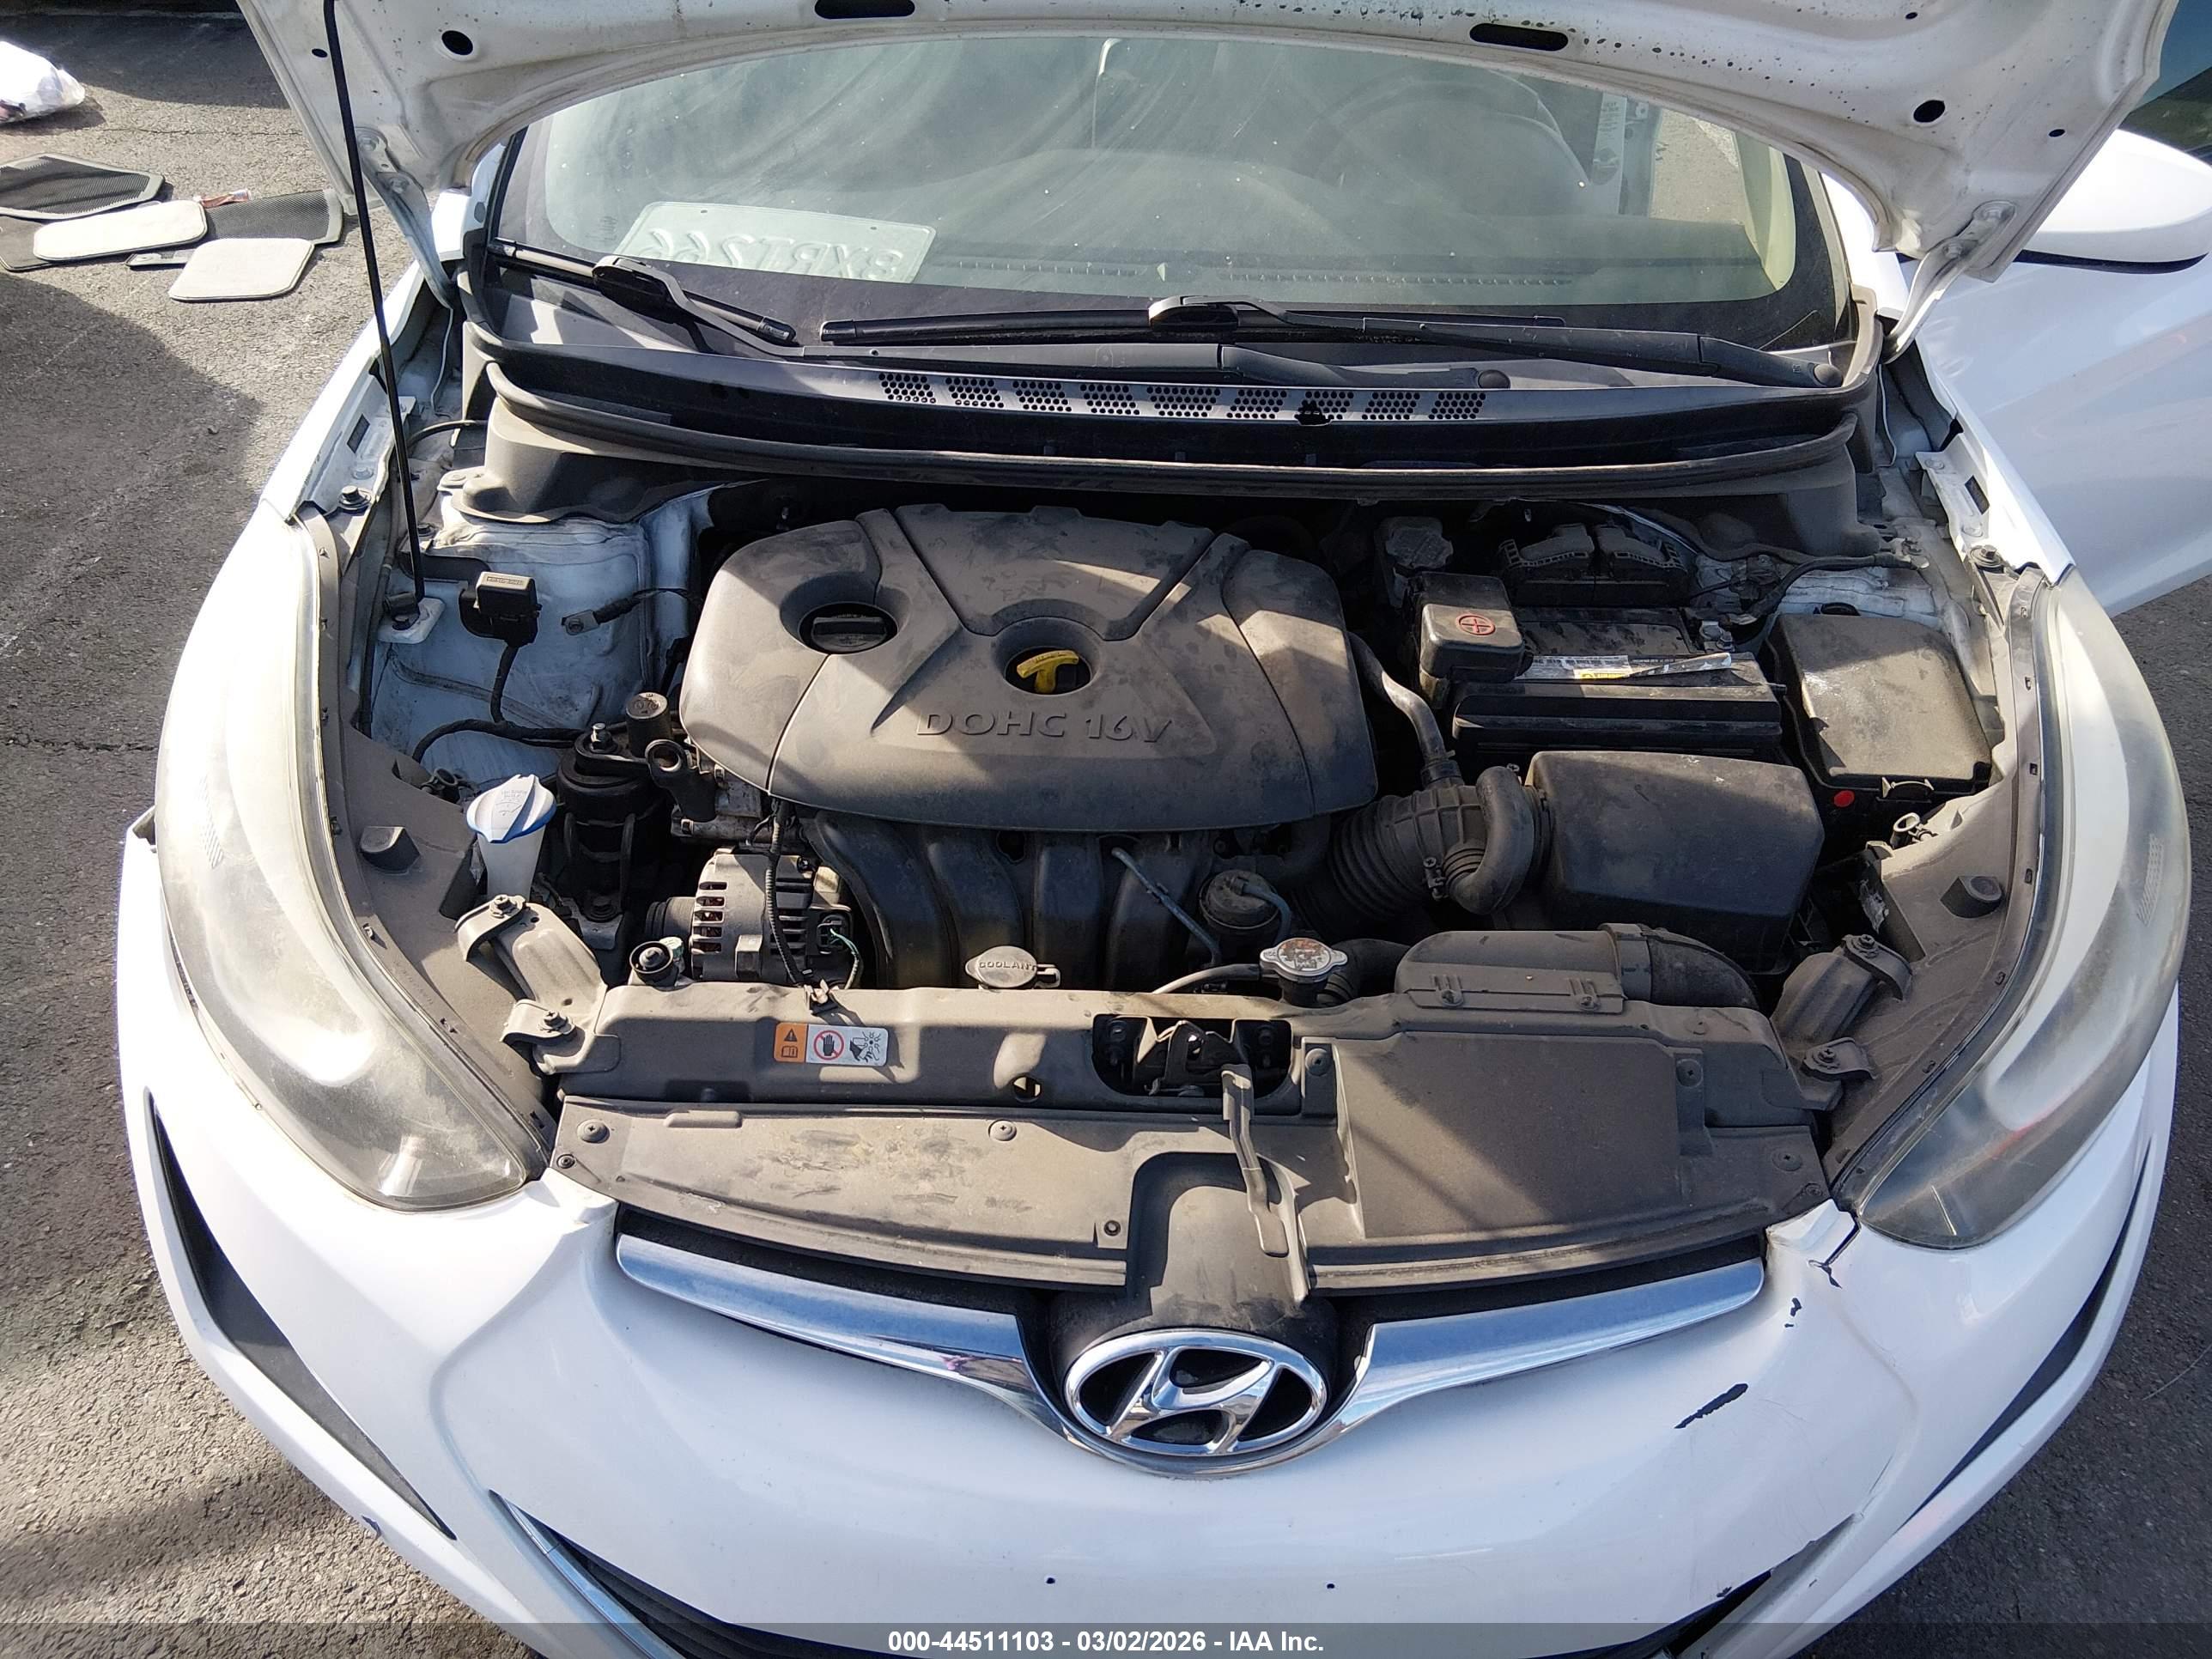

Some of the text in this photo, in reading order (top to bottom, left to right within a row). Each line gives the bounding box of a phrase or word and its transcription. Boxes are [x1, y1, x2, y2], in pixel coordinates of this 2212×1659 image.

[916, 711, 1173, 744] DOHC 16V
[979, 960, 1038, 971] COOLANT
